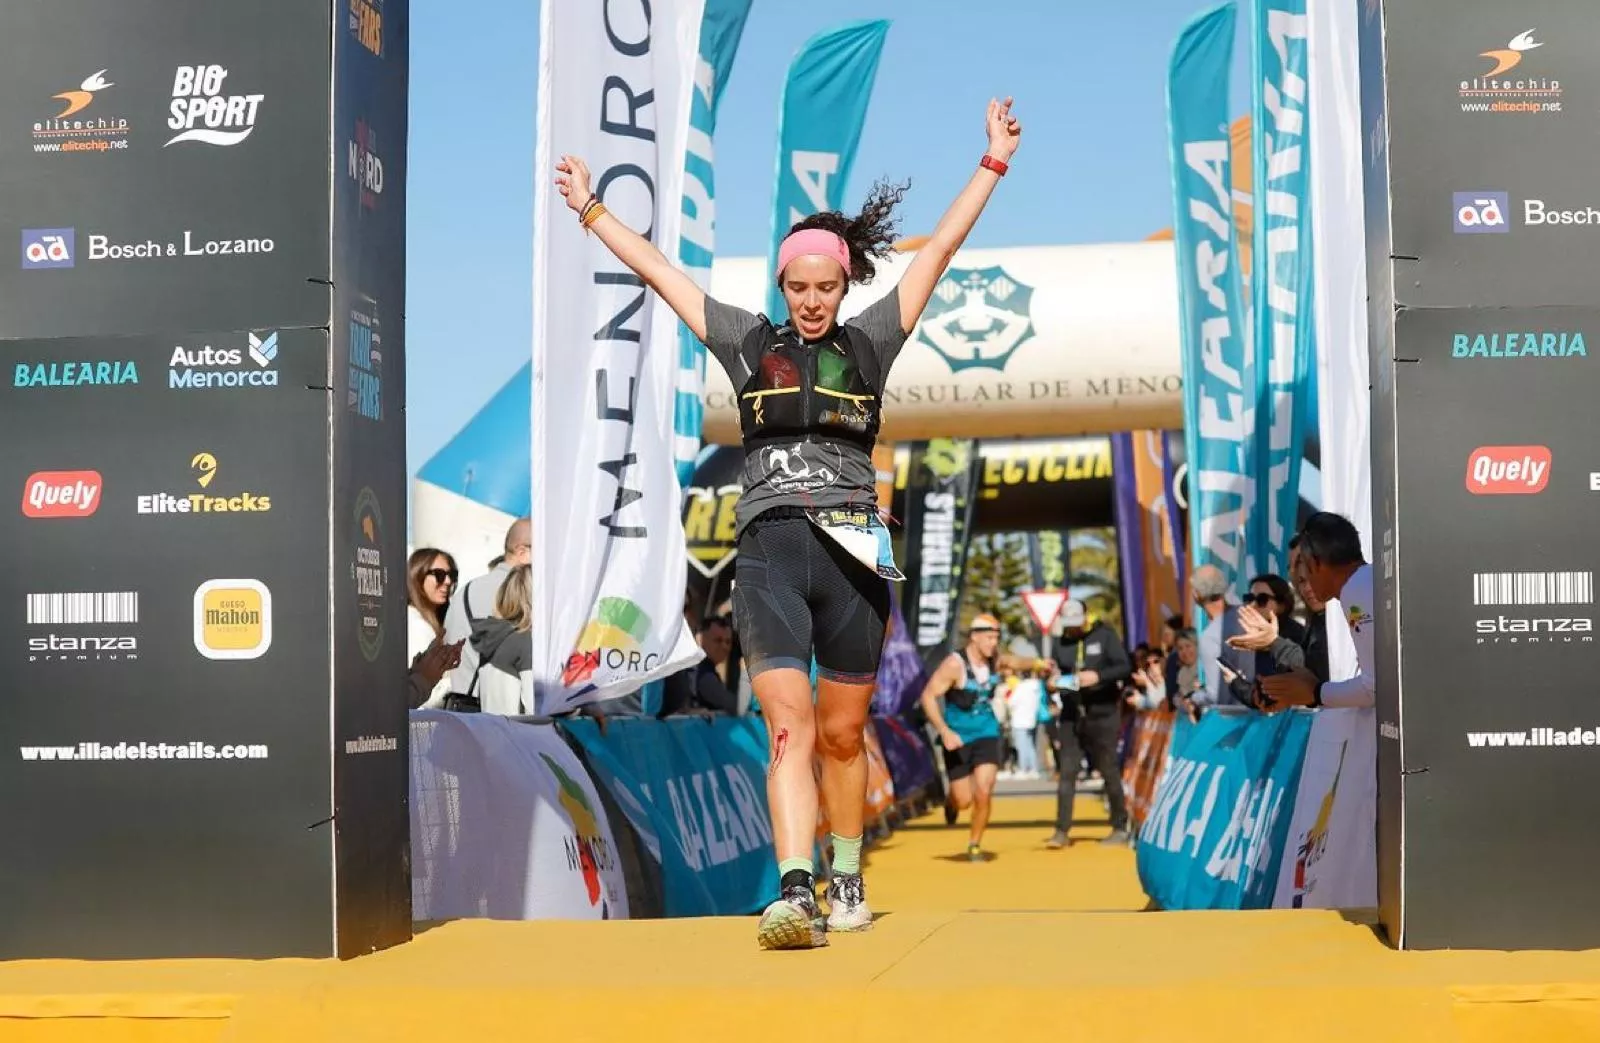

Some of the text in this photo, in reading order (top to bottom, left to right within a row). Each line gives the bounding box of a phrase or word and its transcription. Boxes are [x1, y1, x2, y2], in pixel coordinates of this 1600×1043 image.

[172, 64, 228, 97] BIO
[1460, 78, 1560, 90] elitechip
[167, 94, 265, 129] SPORT
[1460, 101, 1562, 113] www.elitechip.net
[33, 117, 128, 131] elitechip
[33, 140, 129, 153] www.elitechip.net
[1524, 199, 1600, 226] Bosch
[88, 231, 275, 260] Bosch & Lozano
[169, 345, 242, 367] Autos
[168, 368, 279, 389] Menorca
[884, 381, 1014, 403] NSULAR
[1030, 379, 1070, 400] DE
[1473, 456, 1547, 487] Quely
[29, 479, 98, 509] Quely
[137, 492, 271, 514] EliteTracks
[1475, 615, 1593, 634] stanza
[29, 633, 137, 651] stanza
[1476, 635, 1593, 645] premium
[29, 653, 138, 662] premium
[20, 742, 269, 761] www.illadelstrails.com
